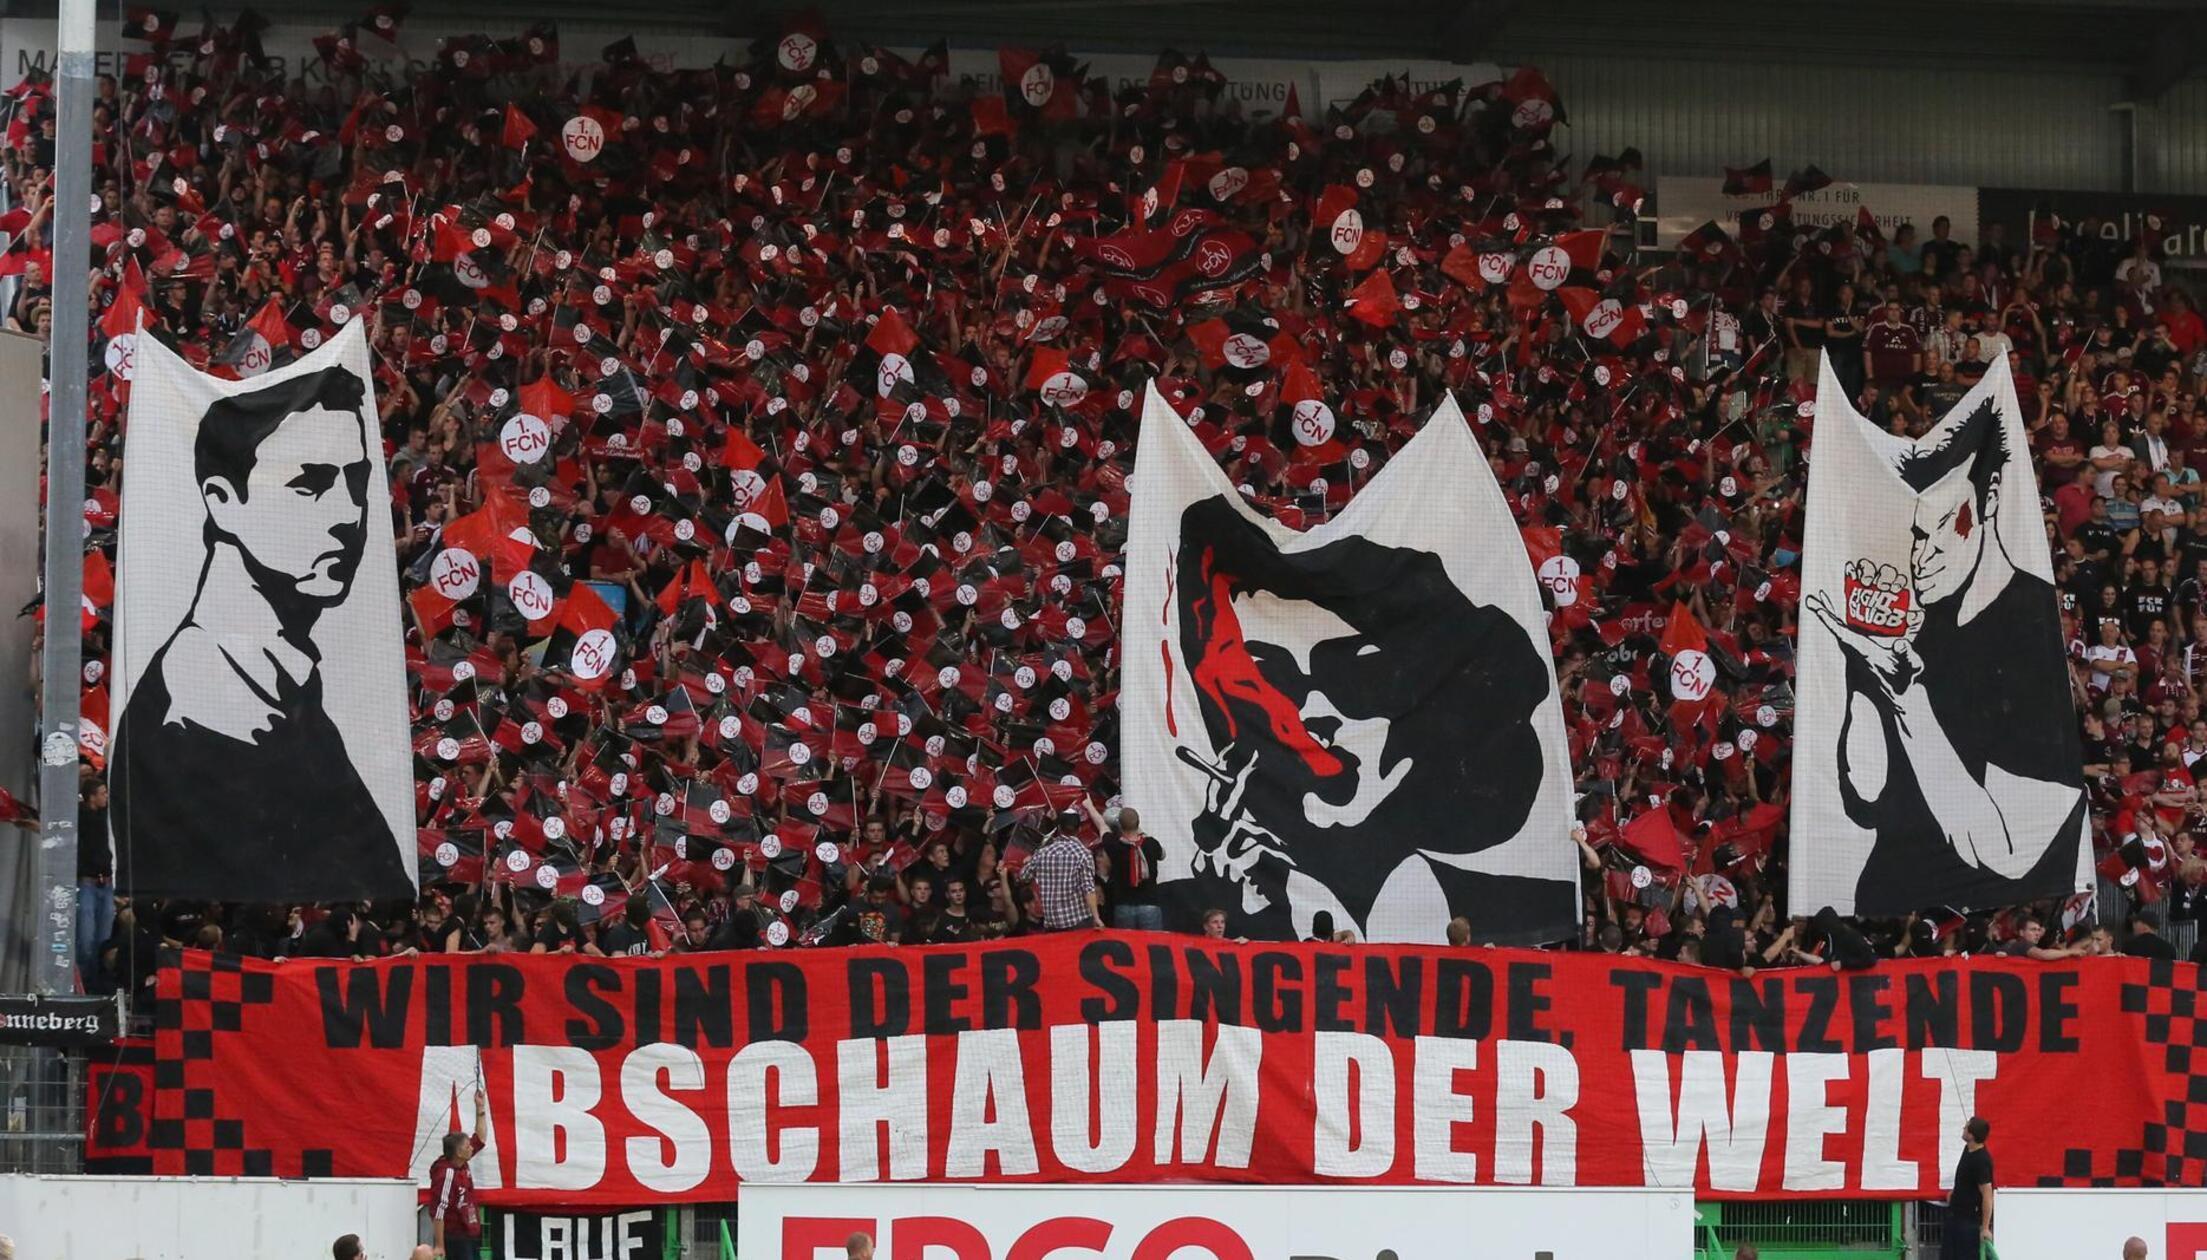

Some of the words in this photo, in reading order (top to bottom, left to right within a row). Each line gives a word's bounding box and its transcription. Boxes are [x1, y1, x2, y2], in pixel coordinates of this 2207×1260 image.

[782, 38, 809, 69] FCN
[1025, 82, 1051, 98] FCN
[577, 120, 589, 134] 1.
[565, 134, 600, 150] FCN
[1334, 227, 1361, 243] FCN
[1201, 249, 1229, 272] FCN
[1480, 255, 1511, 277] FCN
[1548, 250, 1557, 263] 1.
[457, 261, 486, 280] FC
[1530, 264, 1568, 280] FCN
[1589, 308, 1622, 335] FCN
[1230, 337, 1257, 366] FCN
[1044, 388, 1083, 401] FCN
[1313, 406, 1323, 421] 1.
[516, 419, 530, 434] 1.
[1294, 410, 1329, 442] FCN
[506, 432, 547, 455] FCN
[443, 553, 459, 569] 1.
[1555, 560, 1567, 575] 1.
[437, 562, 478, 592] FCN
[526, 575, 536, 590] 1.
[1542, 576, 1579, 594] FCN
[512, 586, 549, 612] FCN
[597, 636, 609, 651] 1.
[574, 641, 606, 675] FCN
[1693, 656, 1704, 673] 1.
[1671, 662, 1709, 696] FCN
[314, 960, 524, 1050] WIR
[563, 961, 809, 1050] SIND
[847, 948, 1041, 1039] DER
[1609, 968, 2080, 1053] TANZENDE
[98, 1073, 144, 1146] B
[409, 1019, 1262, 1193] ABSCHAUM
[1313, 1031, 1579, 1185] DER
[1630, 1047, 1997, 1192] WELT
[504, 1211, 652, 1260] LAUF
